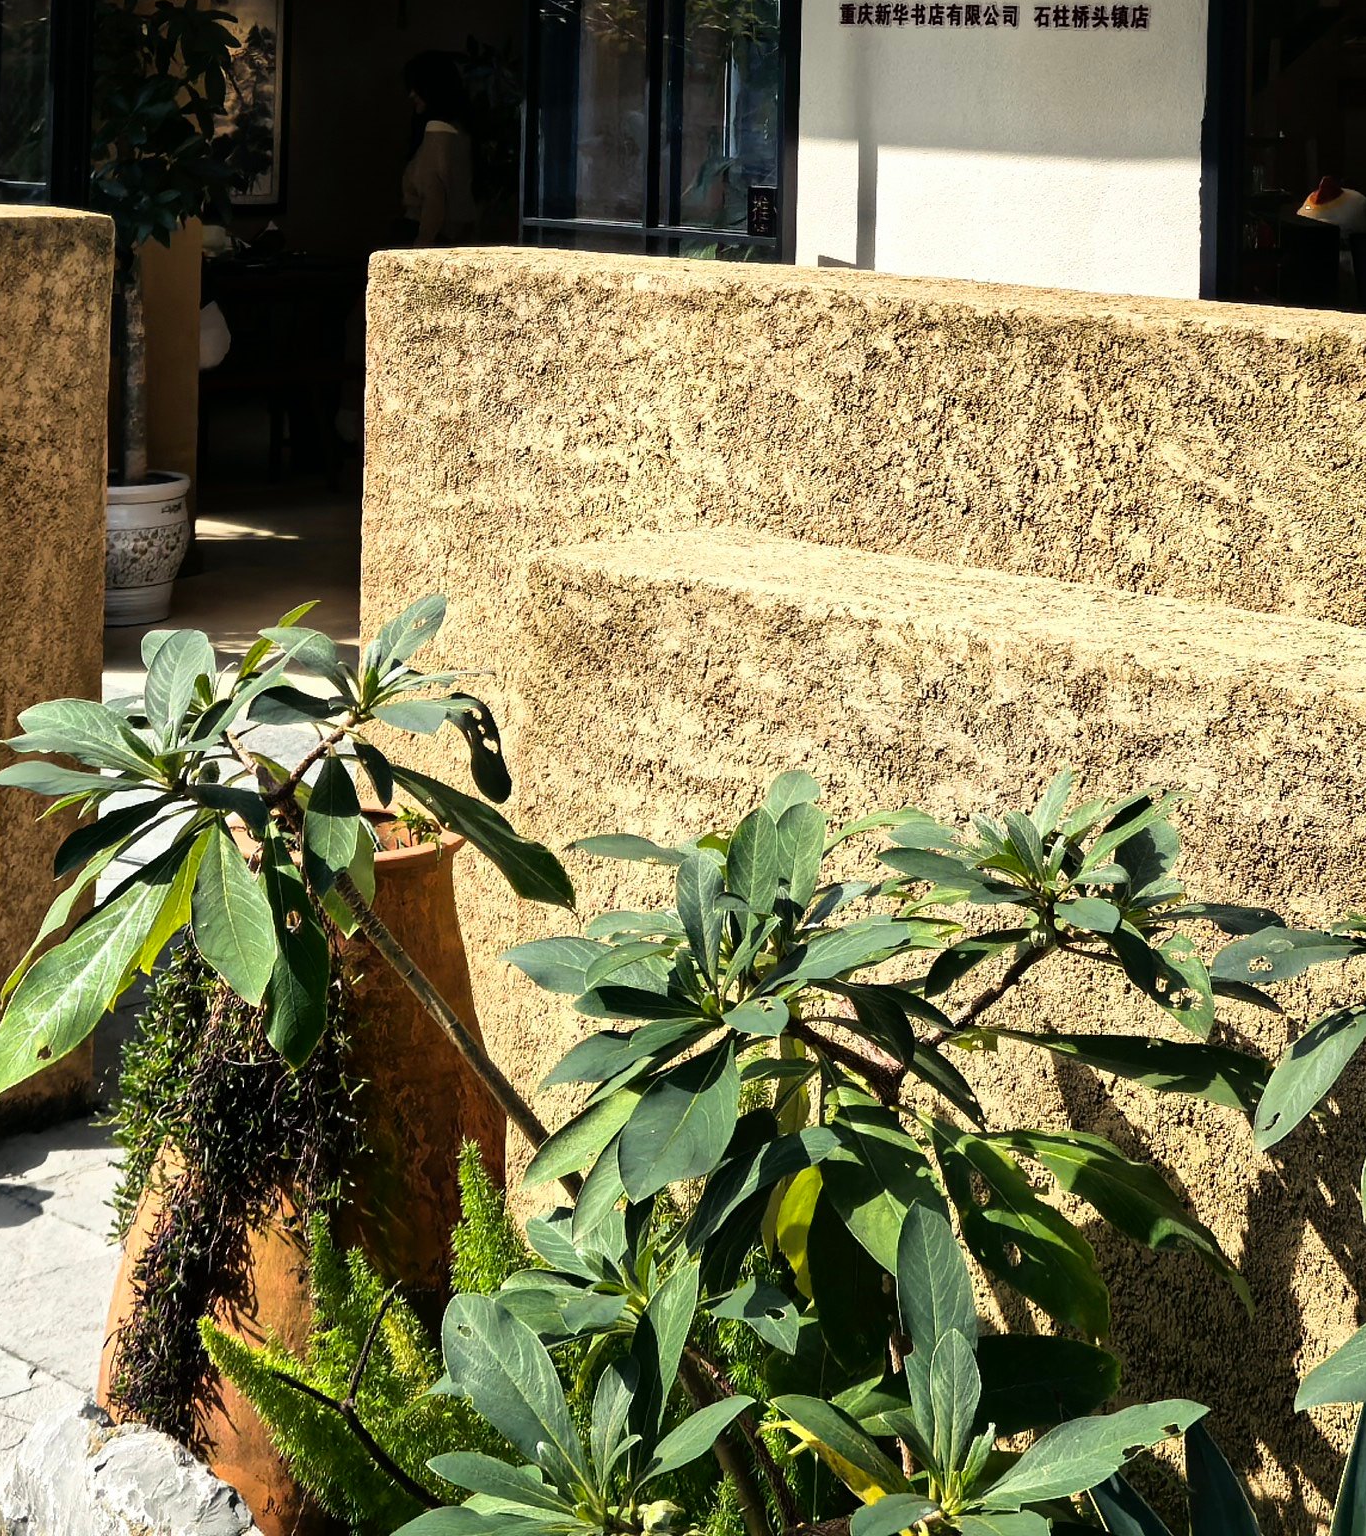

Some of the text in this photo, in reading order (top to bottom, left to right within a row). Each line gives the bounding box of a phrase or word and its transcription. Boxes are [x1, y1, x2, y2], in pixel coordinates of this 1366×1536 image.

[839, 3, 1149, 29] 重庆新华书店有限公司 石柱桥头镇店
